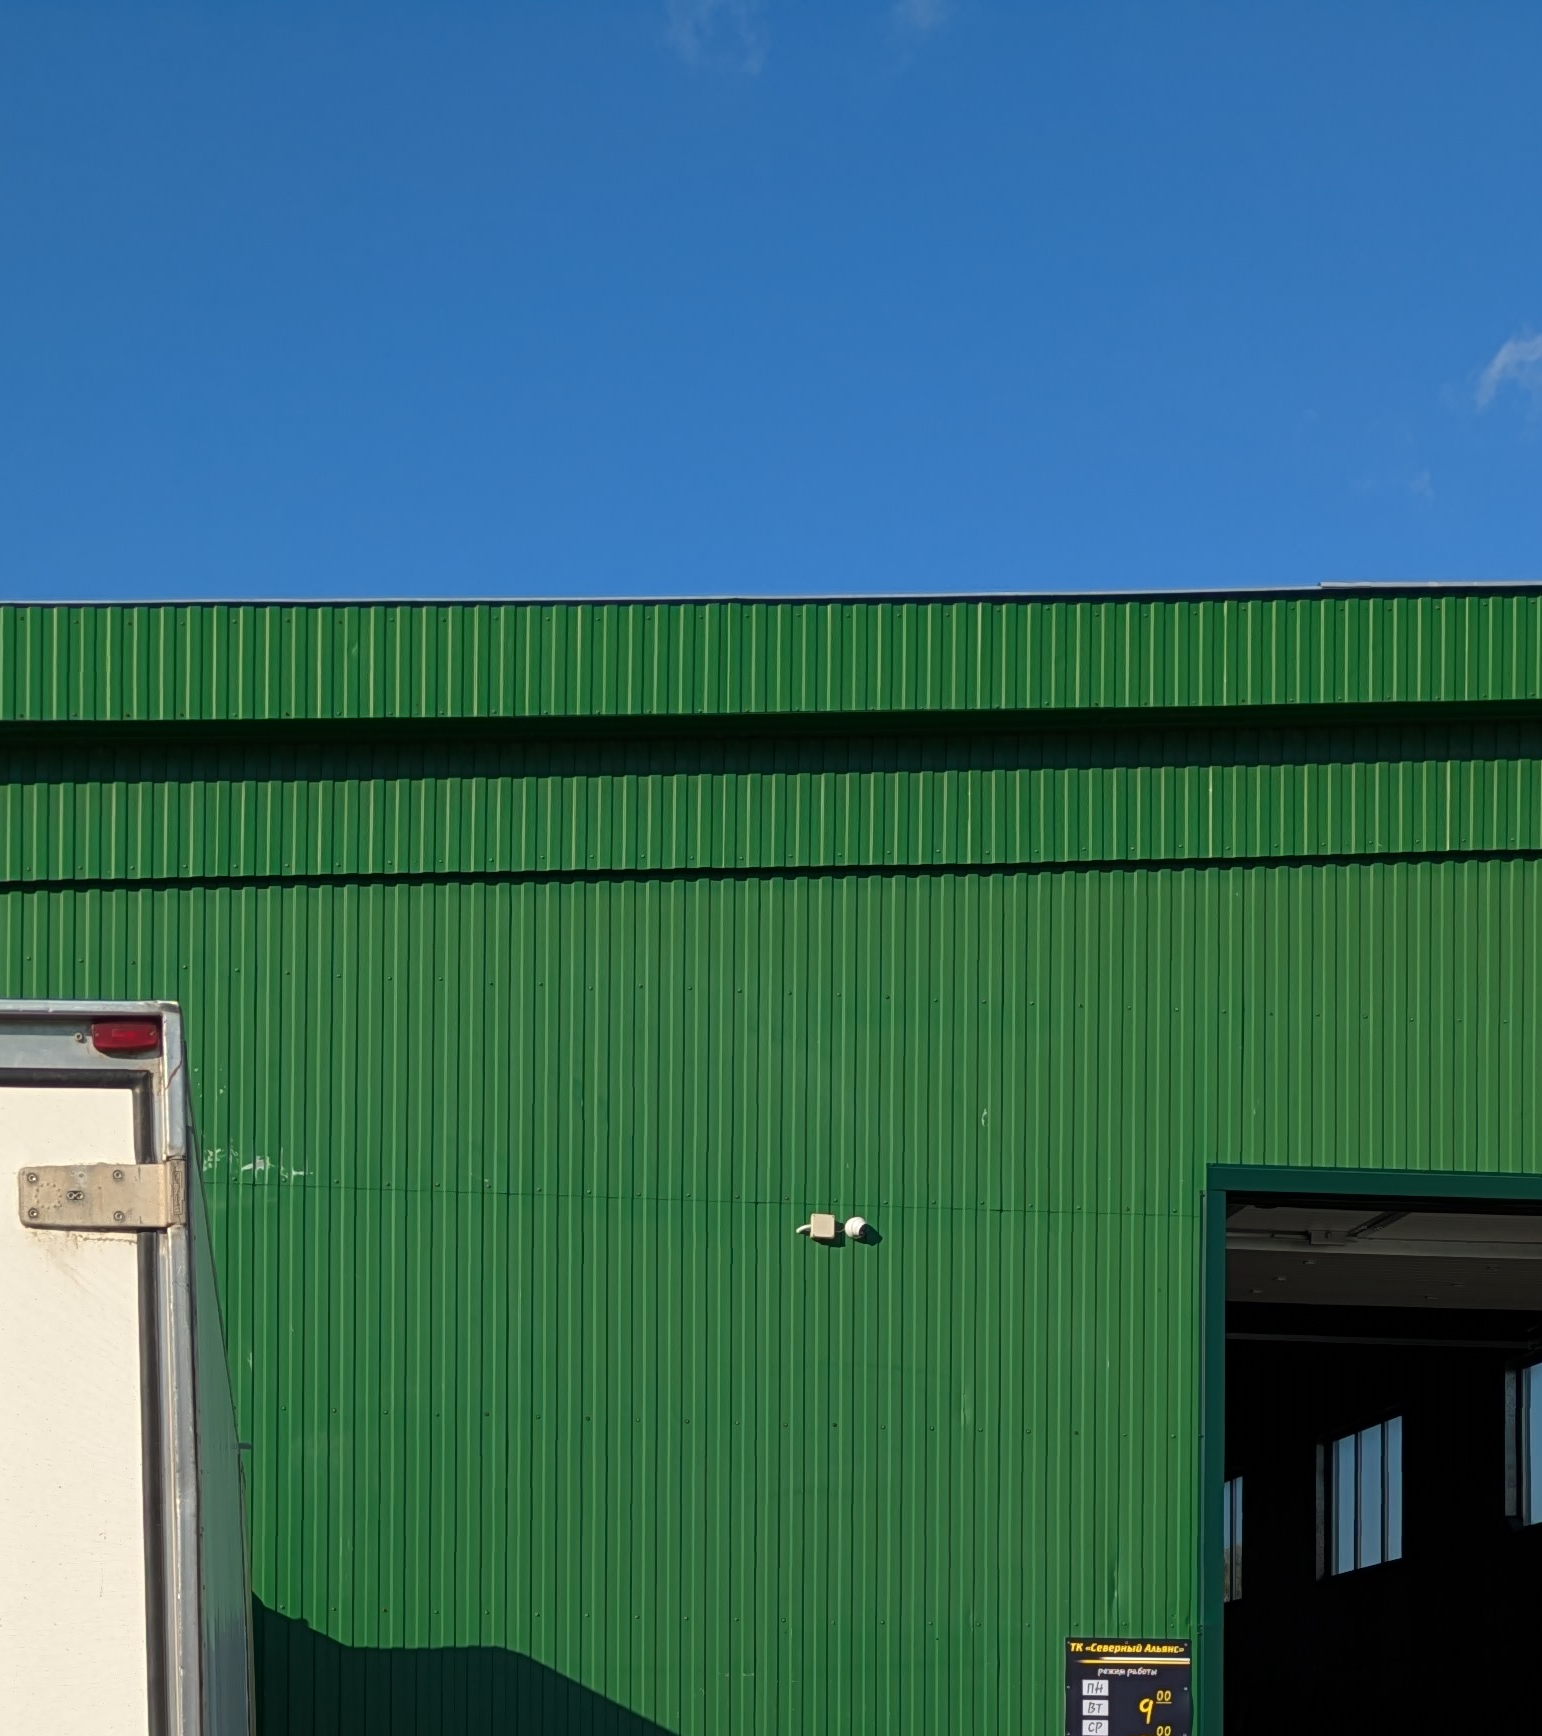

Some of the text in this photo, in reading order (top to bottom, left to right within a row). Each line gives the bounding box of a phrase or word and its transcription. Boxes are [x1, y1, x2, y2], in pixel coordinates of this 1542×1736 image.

[1069, 1642, 1185, 1655] ТК «Северный Альянс»
[1097, 1666, 1158, 1678] режим работы
[1087, 1681, 1104, 1694] ПН
[1087, 1702, 1104, 1714] ВТ
[1139, 1698, 1154, 1725] 9
[1087, 1721, 1103, 1734] СР
